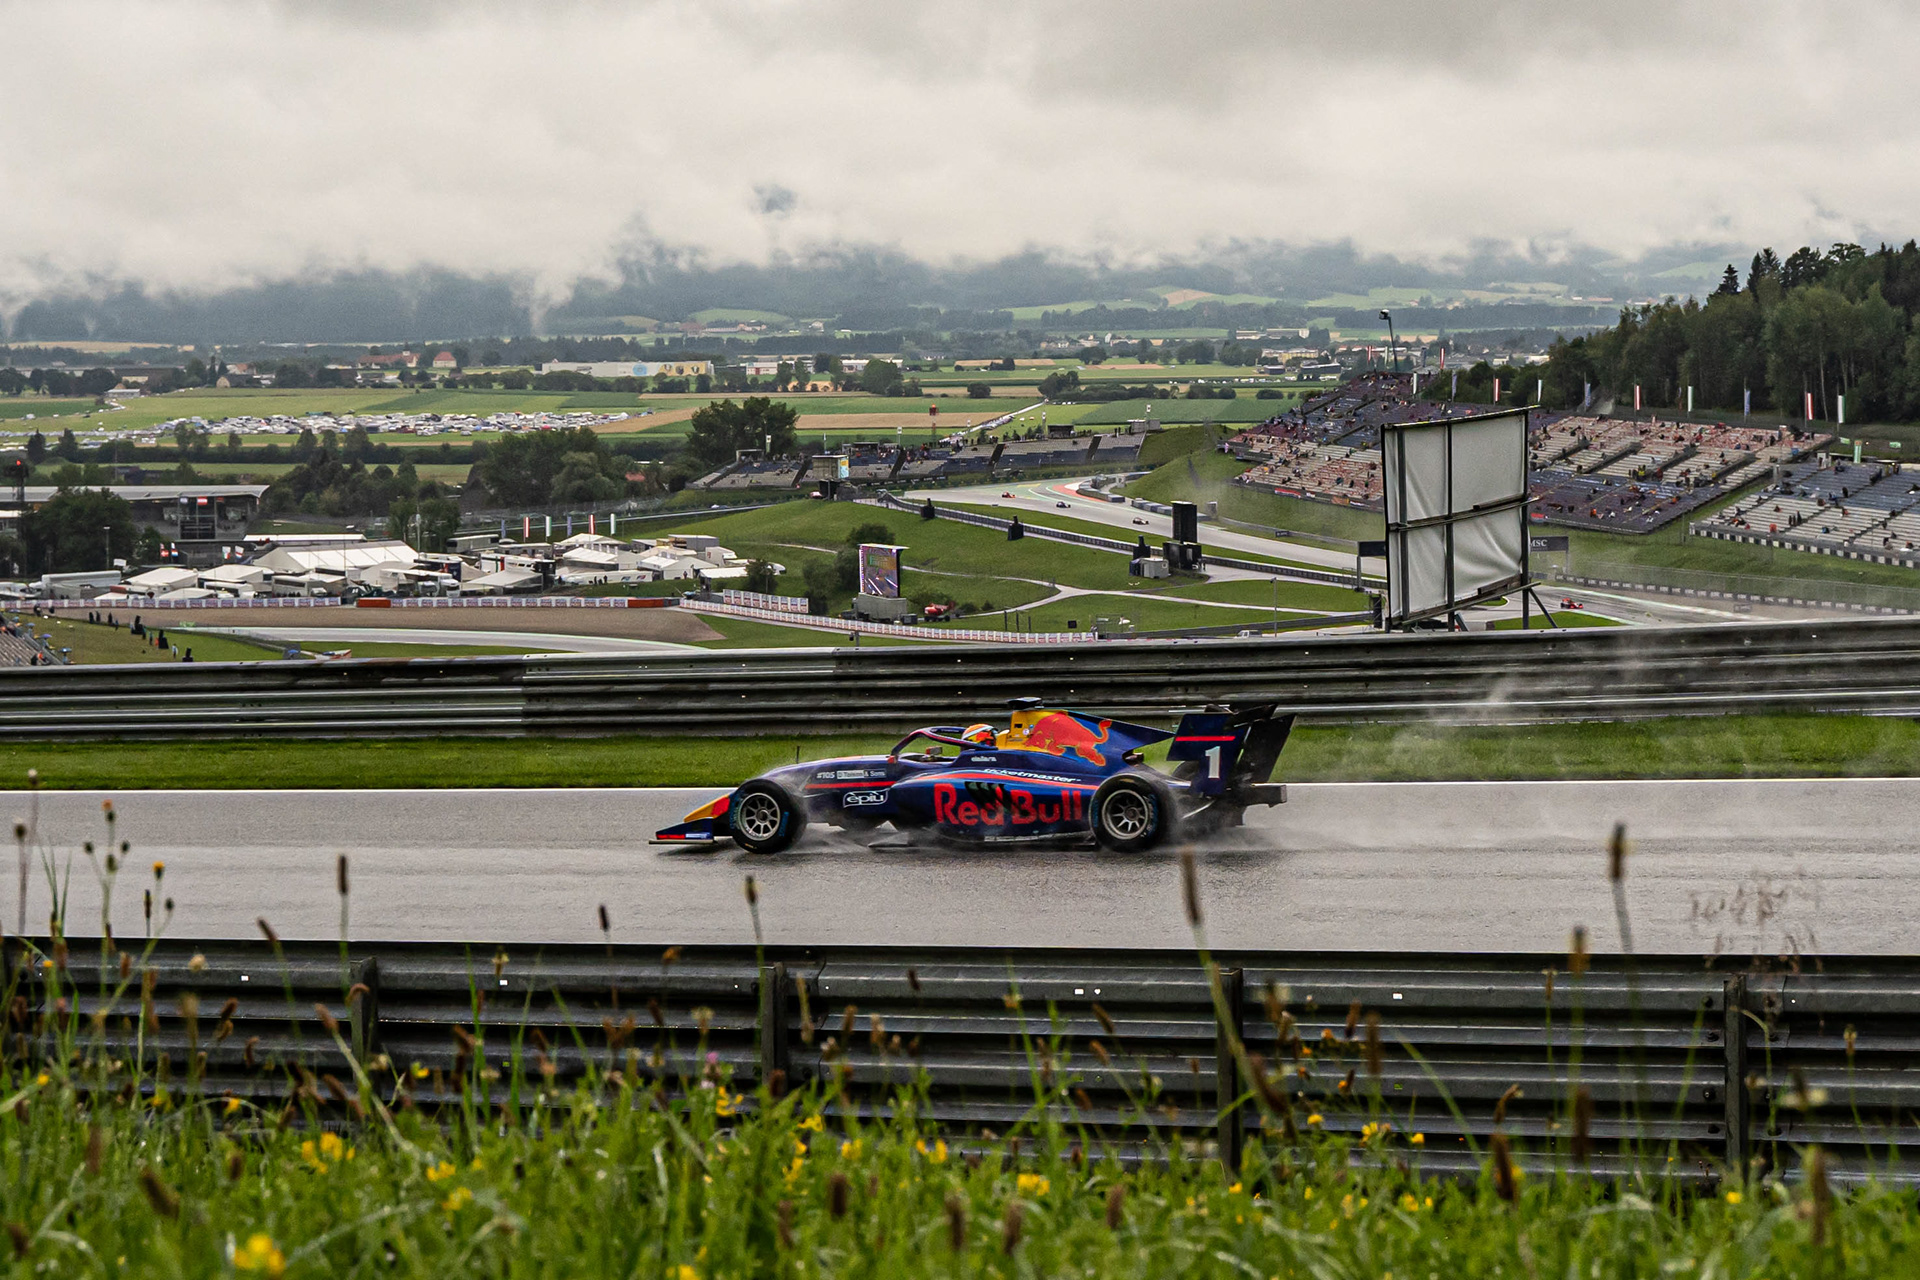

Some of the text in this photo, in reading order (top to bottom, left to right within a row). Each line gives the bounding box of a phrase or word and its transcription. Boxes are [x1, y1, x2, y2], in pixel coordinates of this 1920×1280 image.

[983, 768, 1077, 783] ticketmaster
[1205, 745, 1221, 779] 1
[933, 783, 1005, 826] Red
[1010, 789, 1083, 825] Bull
